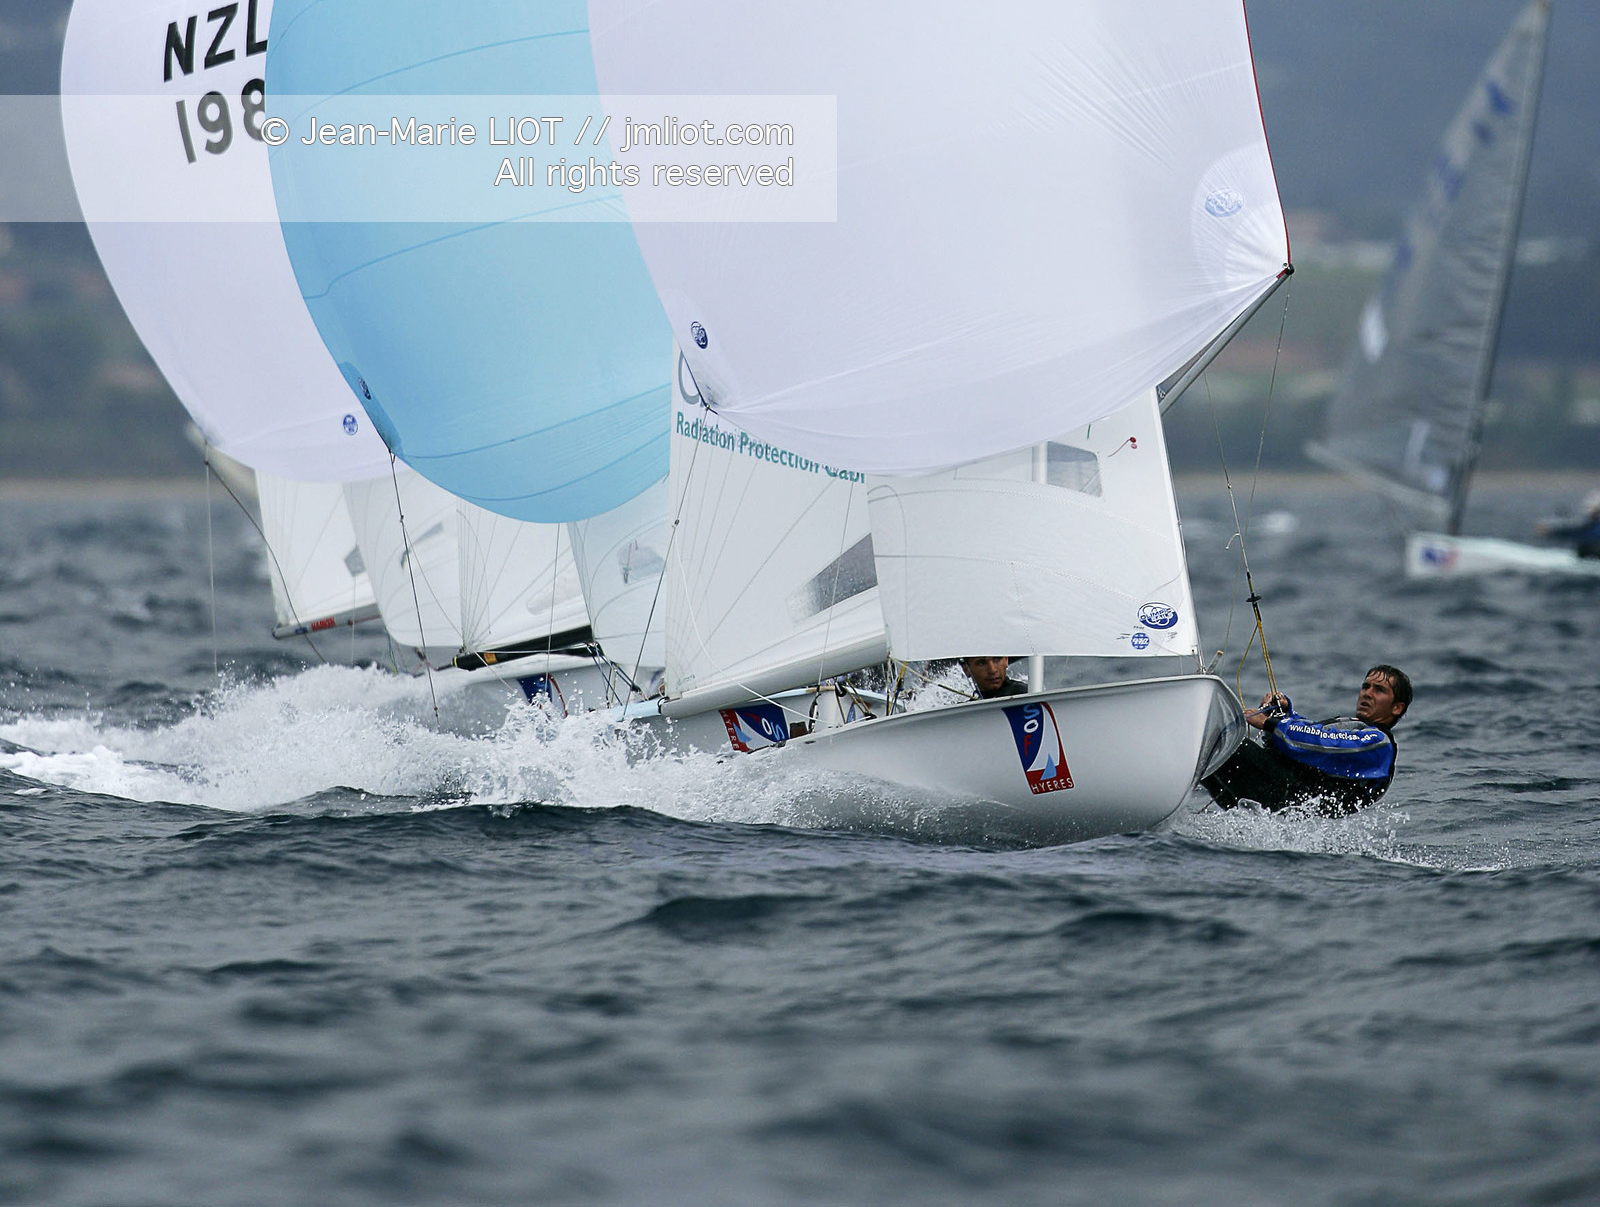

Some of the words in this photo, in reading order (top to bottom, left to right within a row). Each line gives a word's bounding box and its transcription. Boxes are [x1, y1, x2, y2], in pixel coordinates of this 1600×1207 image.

[176, 78, 266, 164] 198
[677, 412, 735, 451] Radiation
[740, 432, 820, 474] Protection
[1023, 703, 1040, 758] SOF
[1031, 777, 1073, 793] HYERES
